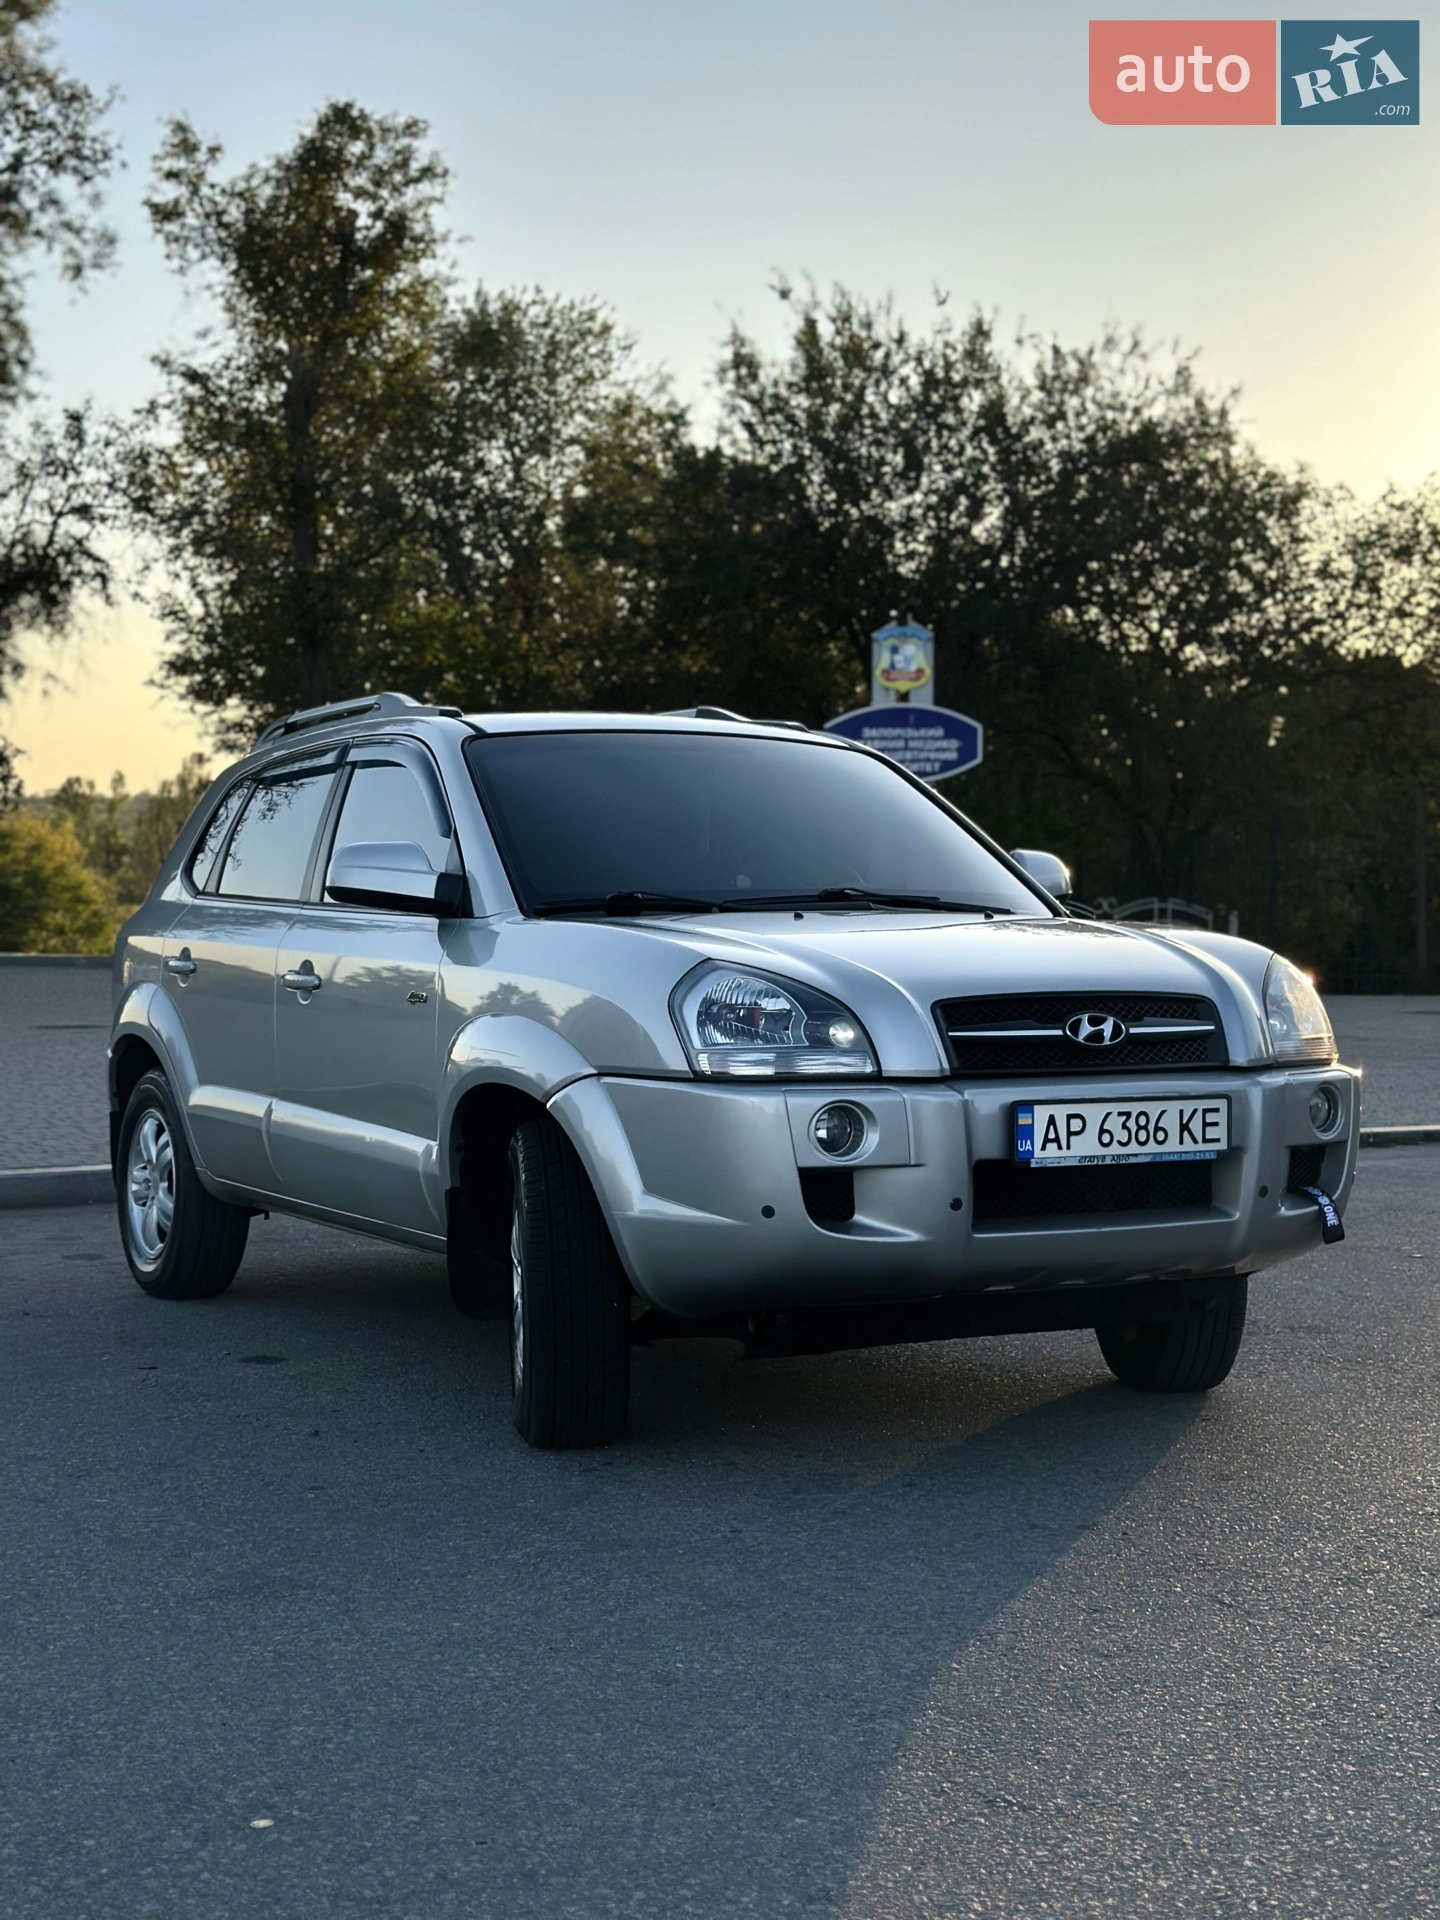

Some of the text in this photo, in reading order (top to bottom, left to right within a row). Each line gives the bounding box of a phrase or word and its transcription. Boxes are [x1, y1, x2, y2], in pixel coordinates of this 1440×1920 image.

[1040, 1107, 1221, 1152] AP 6386 KE
[1018, 1139, 1032, 1151] UA
